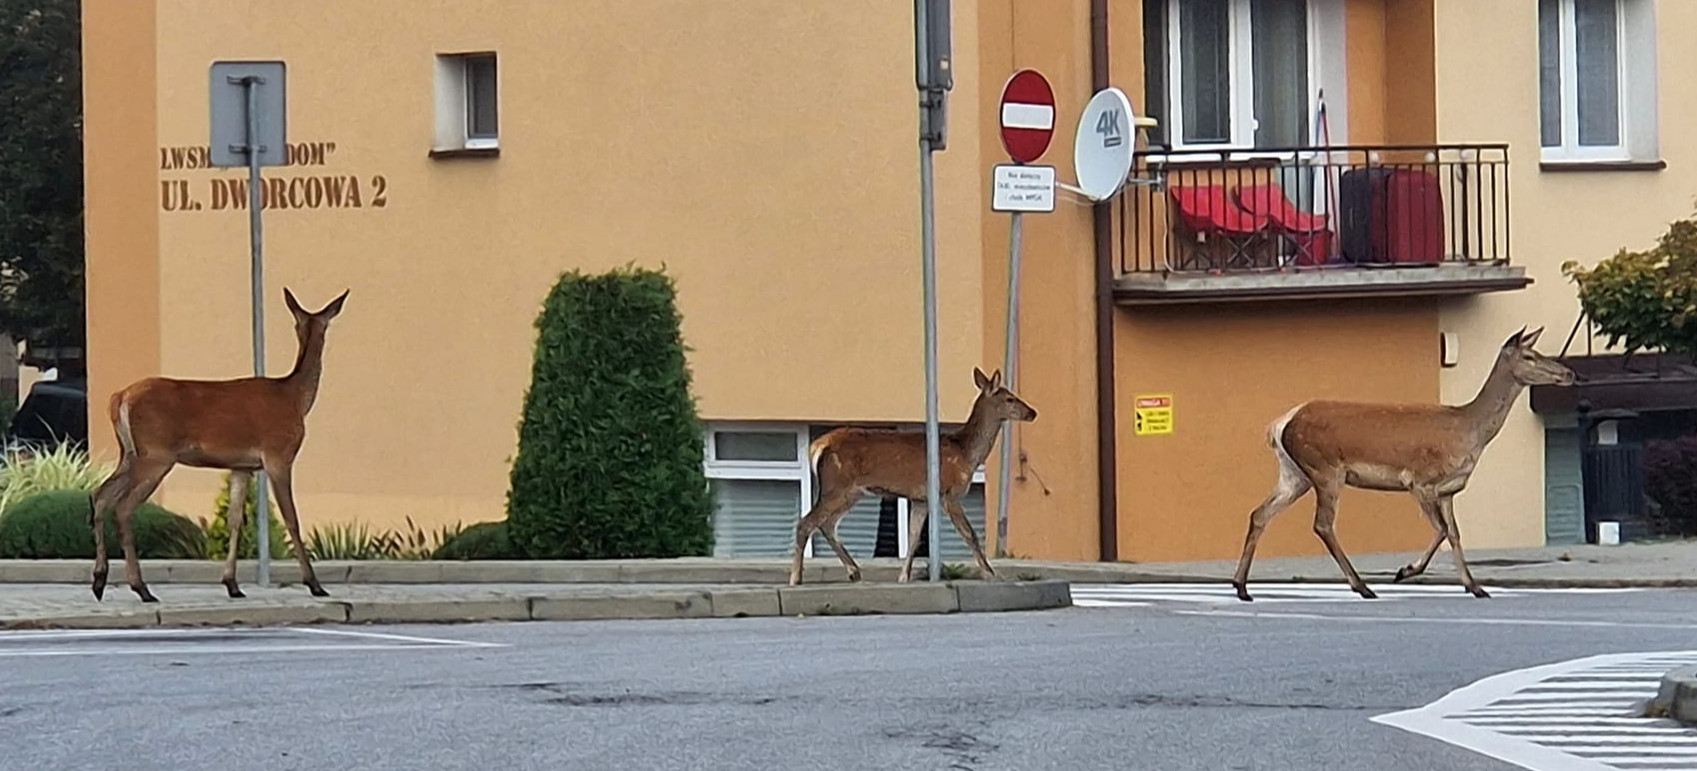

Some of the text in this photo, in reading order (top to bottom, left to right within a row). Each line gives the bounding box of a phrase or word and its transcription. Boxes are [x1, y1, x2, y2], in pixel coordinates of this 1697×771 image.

[1096, 109, 1120, 137] 4K
[161, 180, 202, 211] UL.
[371, 175, 387, 207] 2
